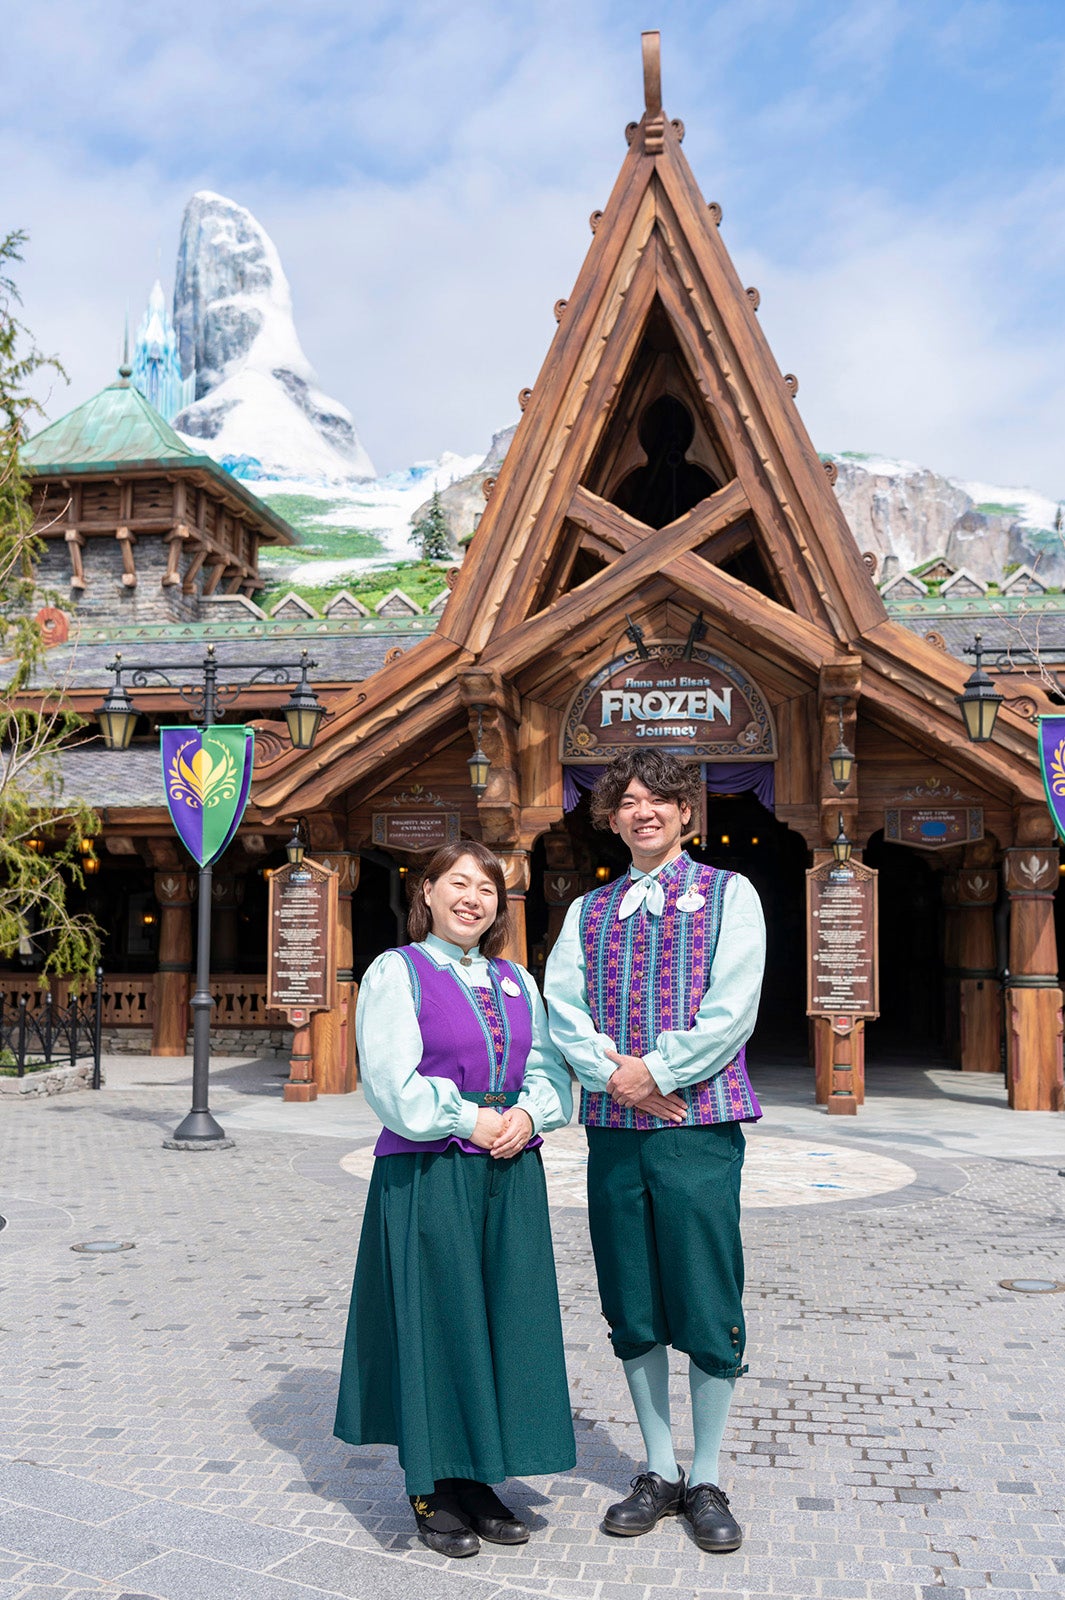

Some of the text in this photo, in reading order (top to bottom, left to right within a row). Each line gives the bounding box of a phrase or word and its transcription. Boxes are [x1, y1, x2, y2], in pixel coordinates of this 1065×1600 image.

[624, 676, 711, 689] Anna and Elsa's
[600, 687, 733, 728] FROZEN
[635, 724, 698, 738] Journey
